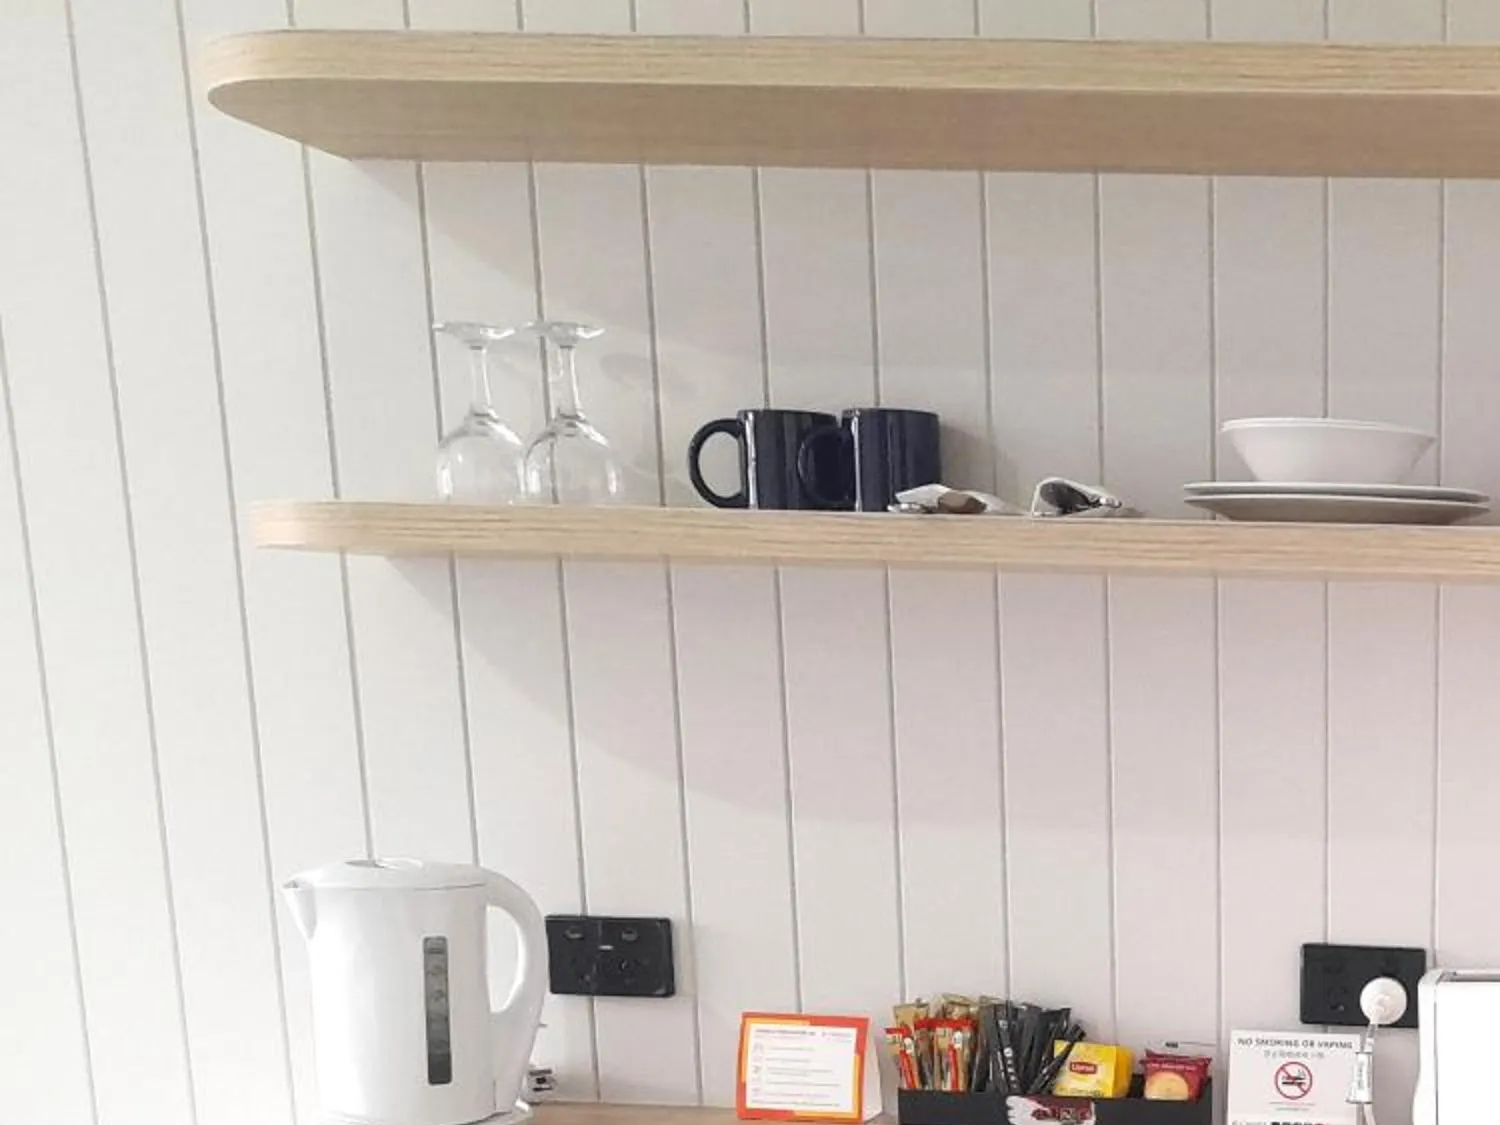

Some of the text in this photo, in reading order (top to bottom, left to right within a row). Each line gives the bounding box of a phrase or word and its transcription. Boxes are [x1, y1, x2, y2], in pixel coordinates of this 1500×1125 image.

[1238, 1038, 1353, 1049] NO SMOKING OR VAPING
